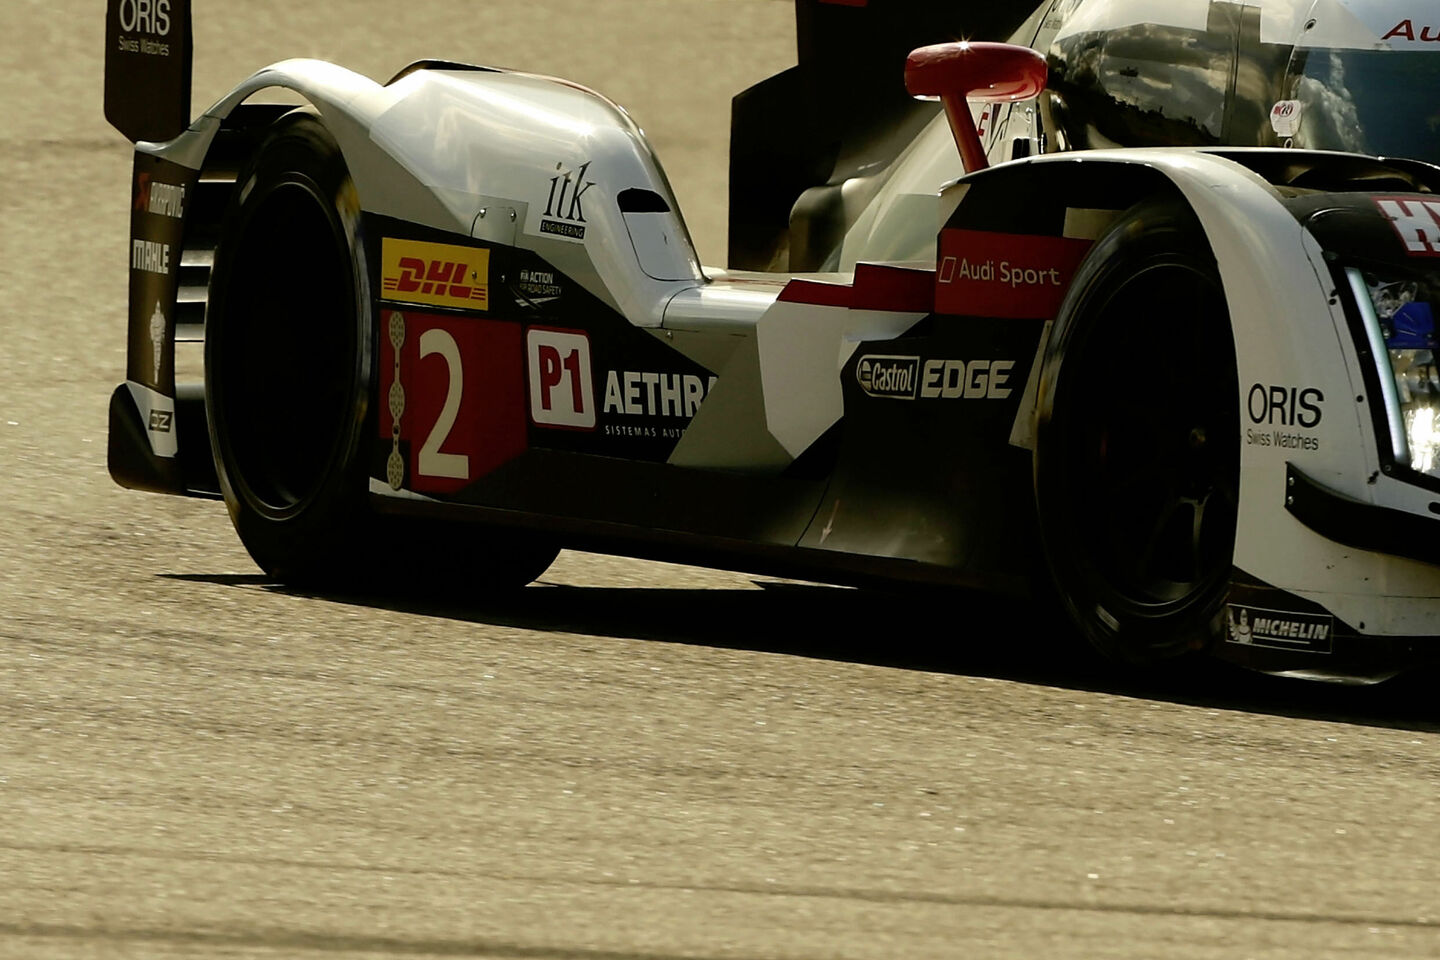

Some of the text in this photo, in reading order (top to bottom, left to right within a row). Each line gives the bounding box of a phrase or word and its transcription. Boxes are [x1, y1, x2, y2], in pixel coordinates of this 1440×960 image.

[543, 160, 597, 223] itk
[133, 239, 170, 275] MAHLE
[959, 258, 1061, 288] Audi Sport
[396, 257, 473, 299] DHL
[530, 271, 553, 284] ACTION
[538, 344, 585, 414] P1
[871, 359, 1016, 399] Castrol EDGE
[418, 328, 470, 480] 2
[1247, 383, 1324, 428] ORIS
[605, 424, 657, 438] SISTEMAS
[1246, 428, 1319, 451] Swiss Watches
[1252, 617, 1330, 641] MICHELIN
